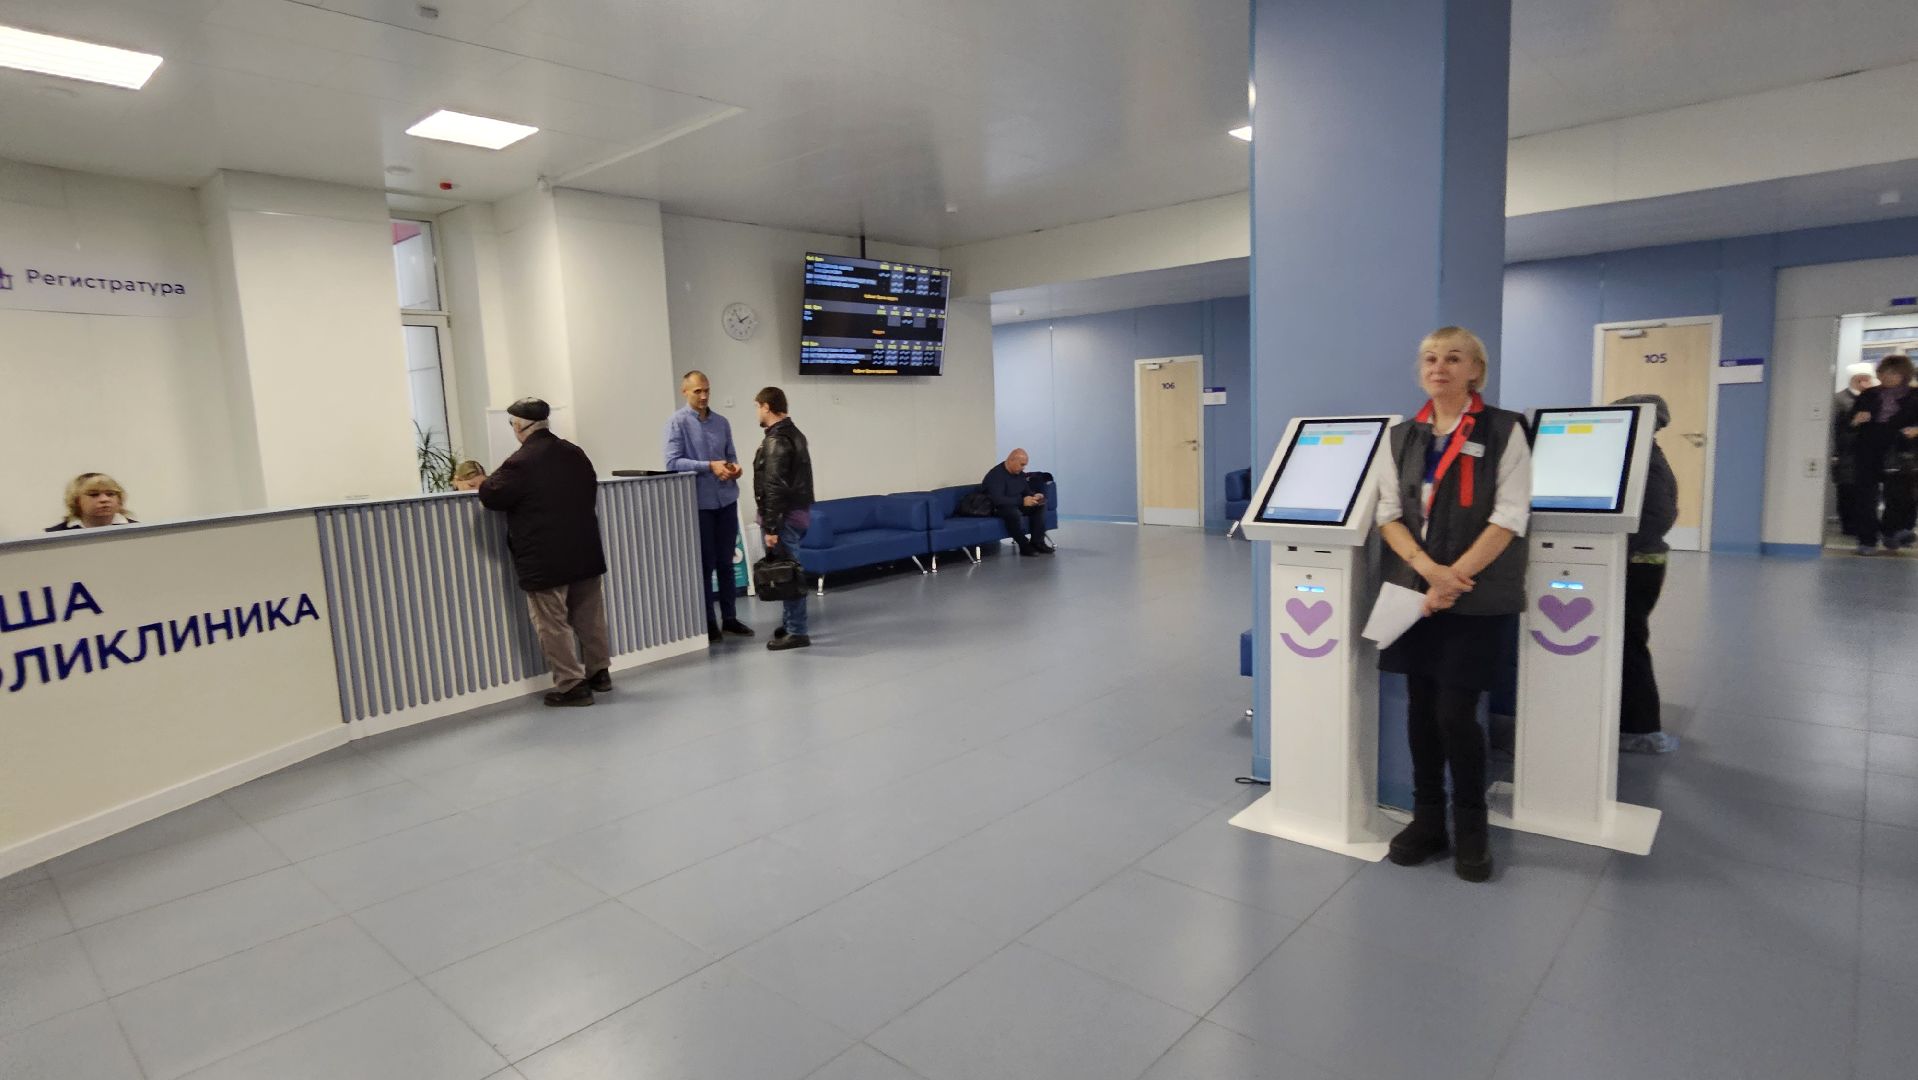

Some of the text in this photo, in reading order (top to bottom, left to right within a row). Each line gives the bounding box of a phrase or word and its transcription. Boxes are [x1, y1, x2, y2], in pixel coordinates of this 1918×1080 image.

[25, 268, 186, 297] Регистратура
[1644, 353, 1668, 364] 105
[1161, 382, 1175, 390] 106
[0, 593, 320, 693] ЛИКЛИНИКА
